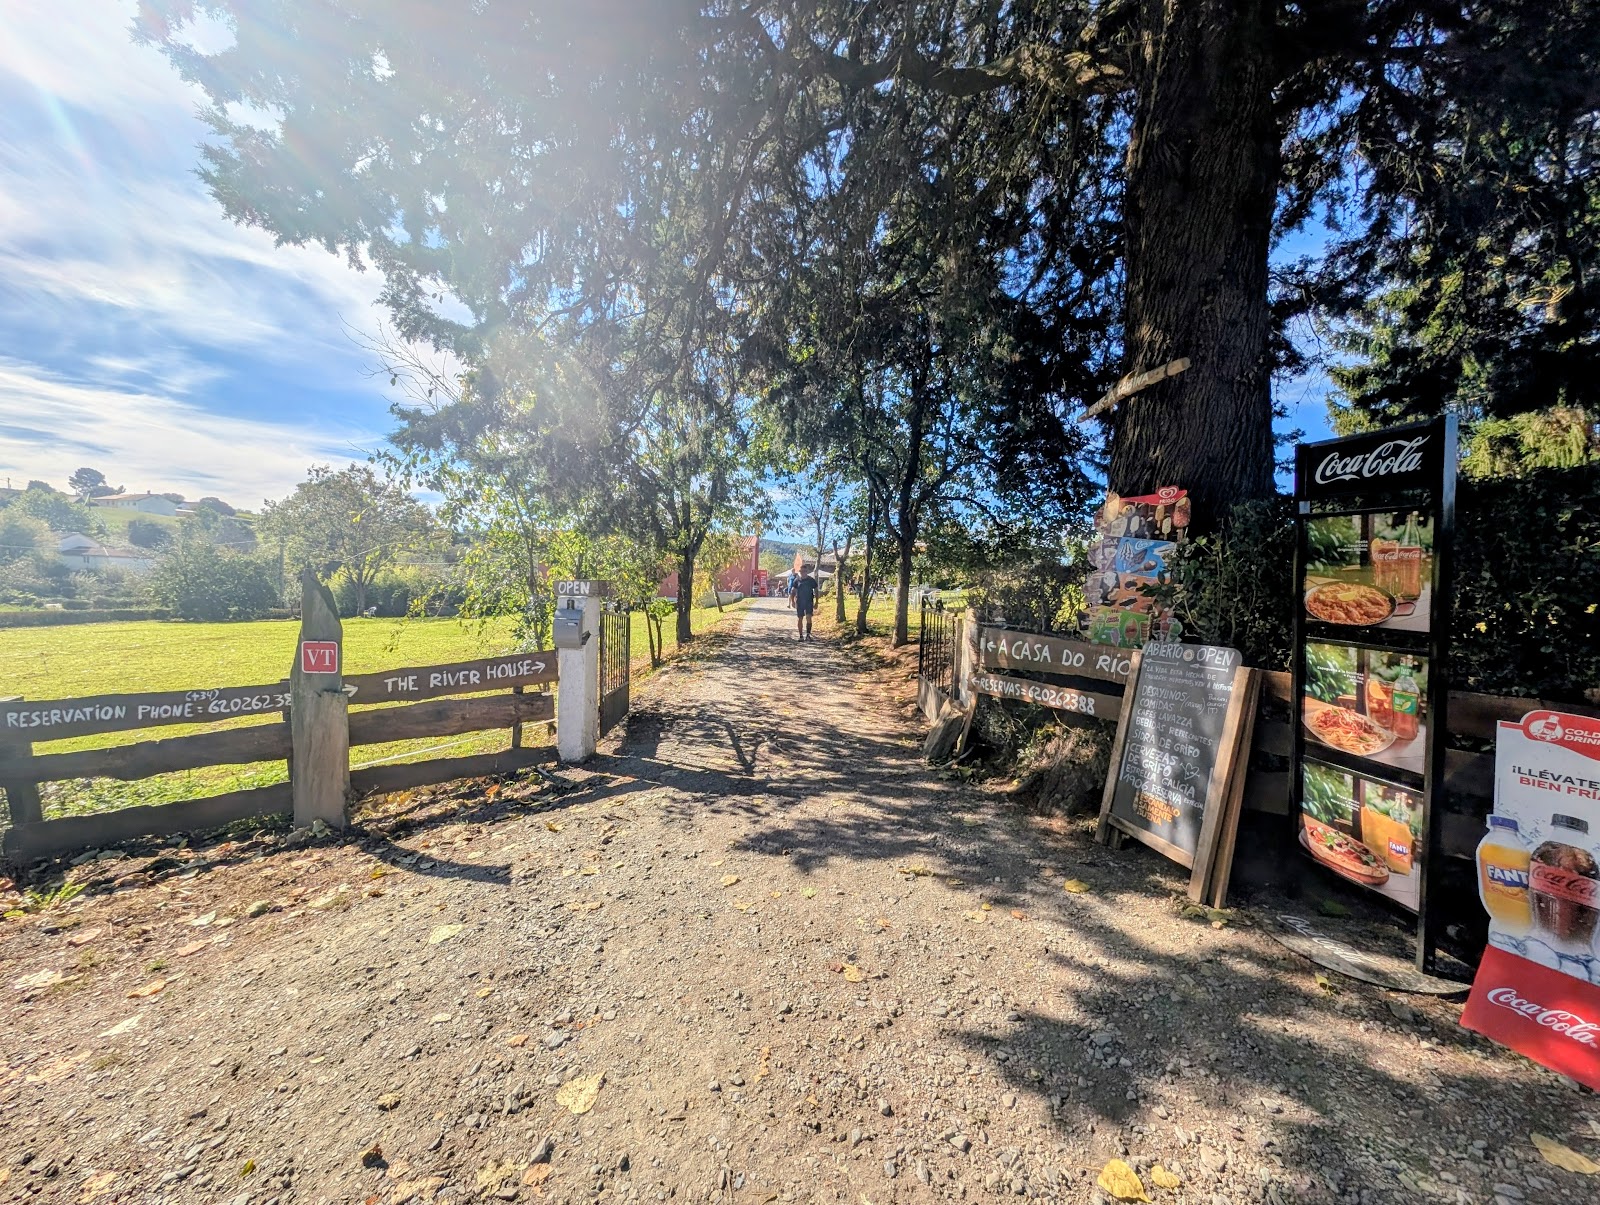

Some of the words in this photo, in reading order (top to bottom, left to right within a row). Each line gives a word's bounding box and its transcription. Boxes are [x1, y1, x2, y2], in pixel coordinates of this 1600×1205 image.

[1315, 435, 1431, 484] Coca-Cola
[558, 581, 591, 594] OPEN
[305, 648, 335, 667] VT
[998, 638, 1008, 655] A
[1011, 640, 1052, 663] CASA
[1062, 649, 1085, 667] DO
[1146, 641, 1183, 659] ABIERTO
[1196, 647, 1235, 667] OPEN
[383, 674, 419, 692] THE
[429, 668, 481, 688] RIVER
[486, 659, 533, 680] HOUSE
[1140, 698, 1175, 711] COMIDAS
[1142, 685, 1187, 701] DESAYUNOS
[7, 704, 127, 728] RESERVATION
[1136, 716, 1166, 731] BEBIDAS
[1159, 713, 1192, 728] LAVAZZA
[1132, 729, 1155, 744] SIDRA
[1159, 737, 1171, 749] DE
[1174, 743, 1200, 757] GRIFO
[1128, 753, 1139, 764] DE
[1142, 759, 1172, 777] GRIFO
[1123, 773, 1149, 791] 1906
[1152, 784, 1182, 804] RESERVA
[1125, 764, 1156, 782] ESTRELLA
[1161, 778, 1195, 798] GALICIA
[1519, 776, 1562, 792] BIEN
[1139, 801, 1173, 822] SAMENTE
[1486, 864, 1529, 885] FANT
[1487, 987, 1600, 1045] Coca-Cola
